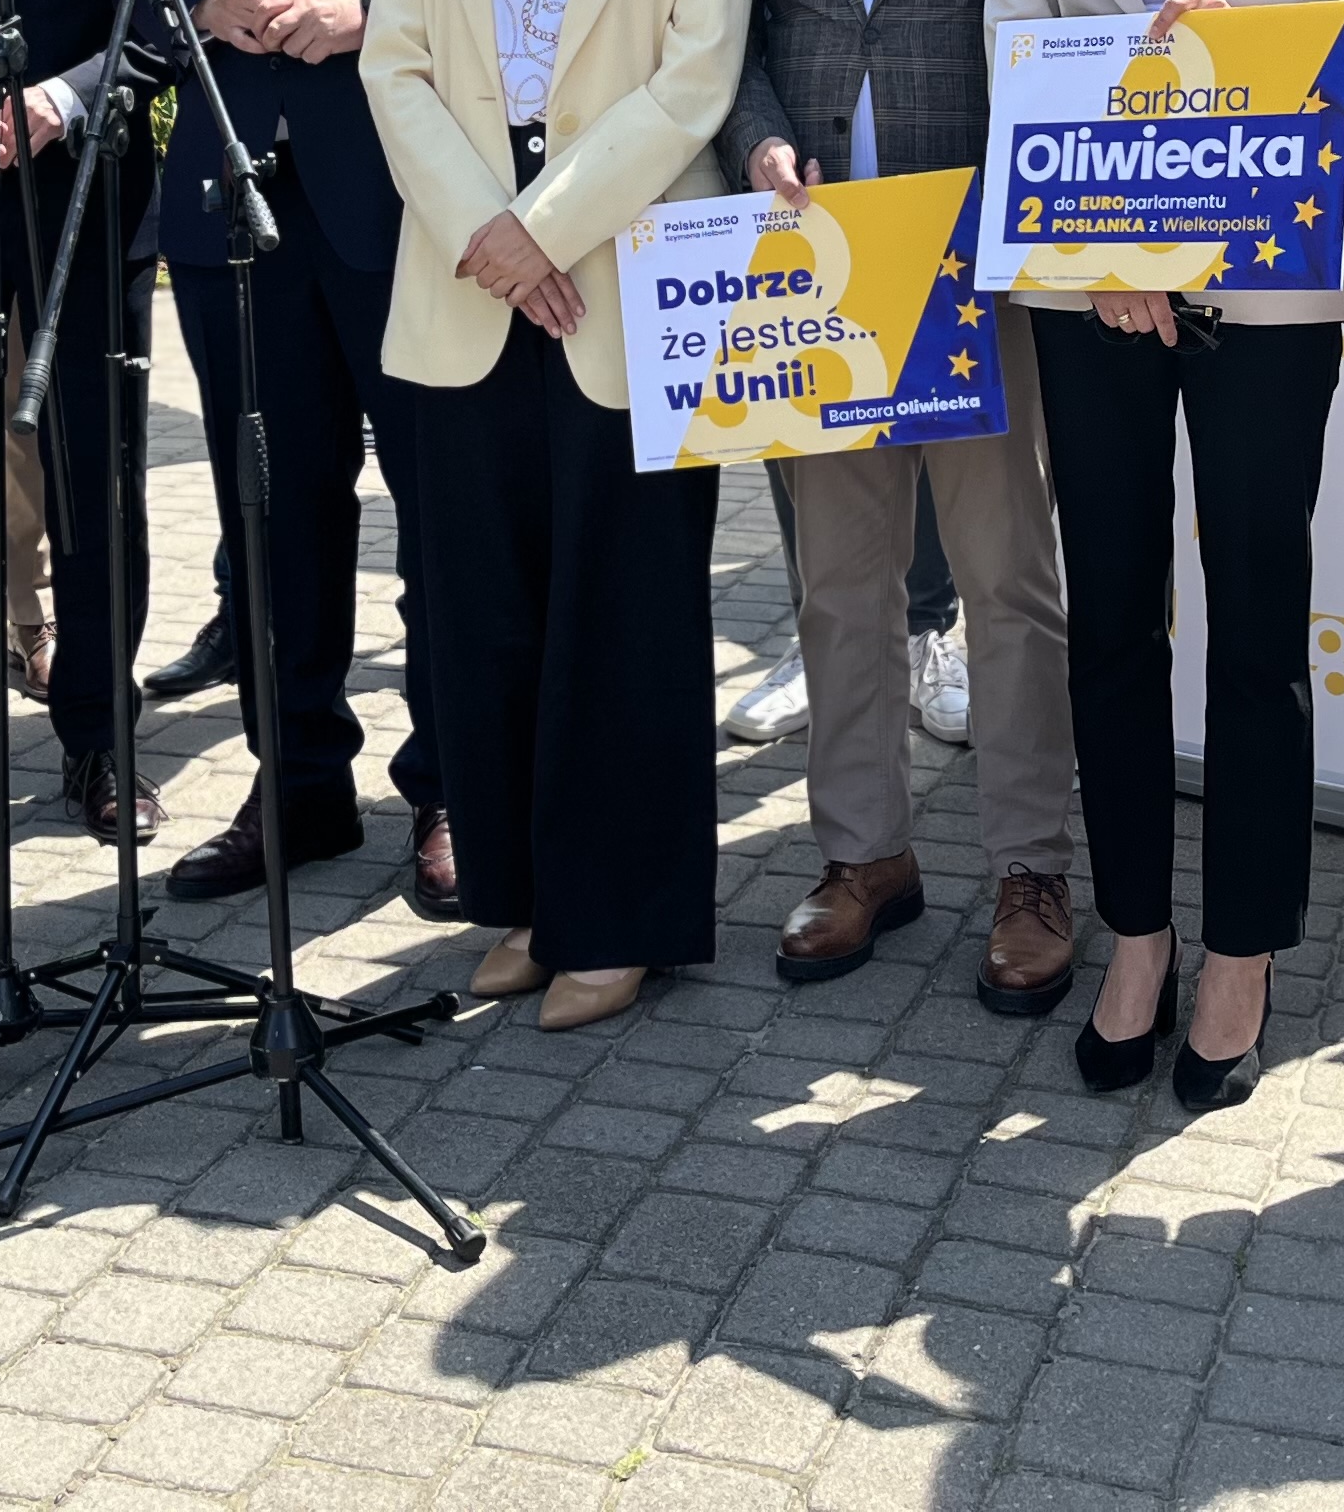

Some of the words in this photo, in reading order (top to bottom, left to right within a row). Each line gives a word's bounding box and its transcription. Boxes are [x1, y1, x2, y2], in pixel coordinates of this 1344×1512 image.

[1042, 38, 1081, 49] Polska
[1083, 36, 1114, 47] 2050
[1129, 46, 1171, 57] DROGA
[1107, 82, 1249, 117] Barbara
[1016, 124, 1304, 182] Oliwiecka
[752, 209, 802, 224] TRZECIA
[1018, 197, 1042, 233] 2
[1054, 195, 1075, 212] do
[1079, 192, 1227, 215] EUROparlamentu
[664, 218, 704, 233] Polska
[707, 215, 739, 227] 2050
[756, 221, 801, 234] DROGA
[1052, 215, 1145, 234] POSŁANKA
[1149, 219, 1158, 233] z
[1161, 214, 1271, 238] Wielkopolski
[656, 267, 823, 310] Dobrze,
[660, 323, 706, 360] że
[720, 306, 877, 365] jesteś...
[664, 380, 703, 410] w
[715, 359, 817, 407] Unii!
[828, 402, 894, 424] Barbara
[897, 393, 981, 417] Oliwiecka
